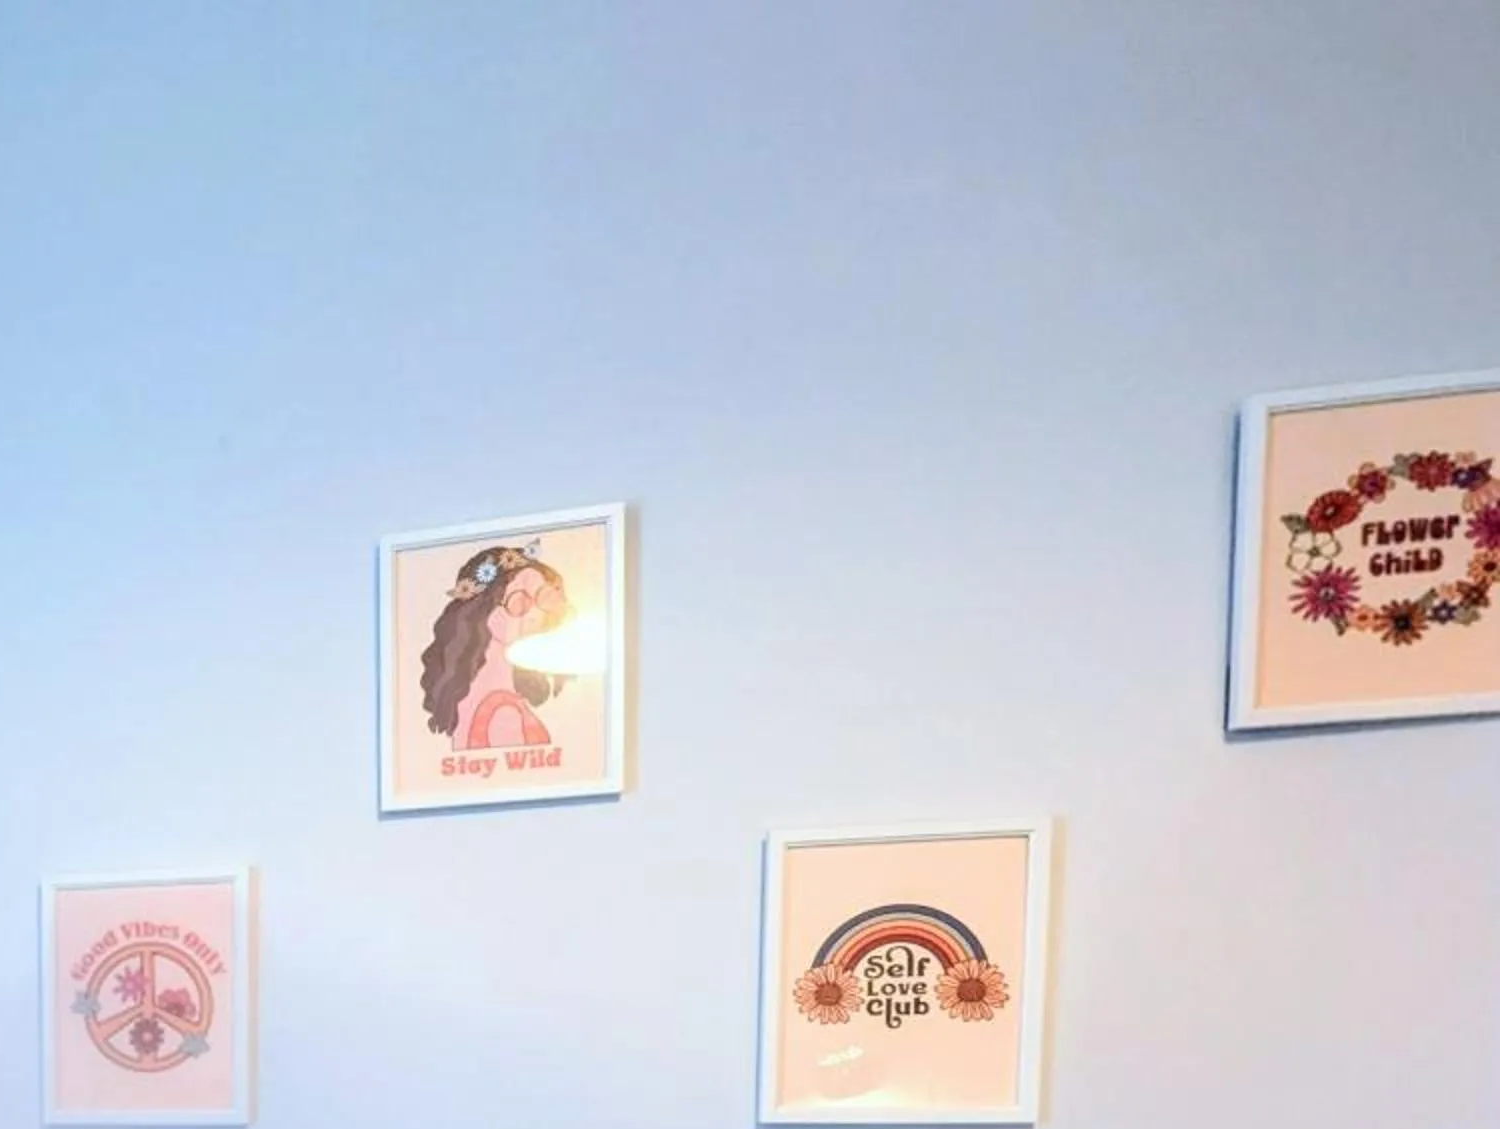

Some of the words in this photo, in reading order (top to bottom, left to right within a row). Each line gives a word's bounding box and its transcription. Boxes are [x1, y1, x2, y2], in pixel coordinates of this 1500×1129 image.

[440, 756, 497, 779] Stay
[504, 747, 563, 771] Wild
[863, 945, 931, 979] Self
[867, 981, 928, 996] Love
[866, 997, 930, 1030] Club
